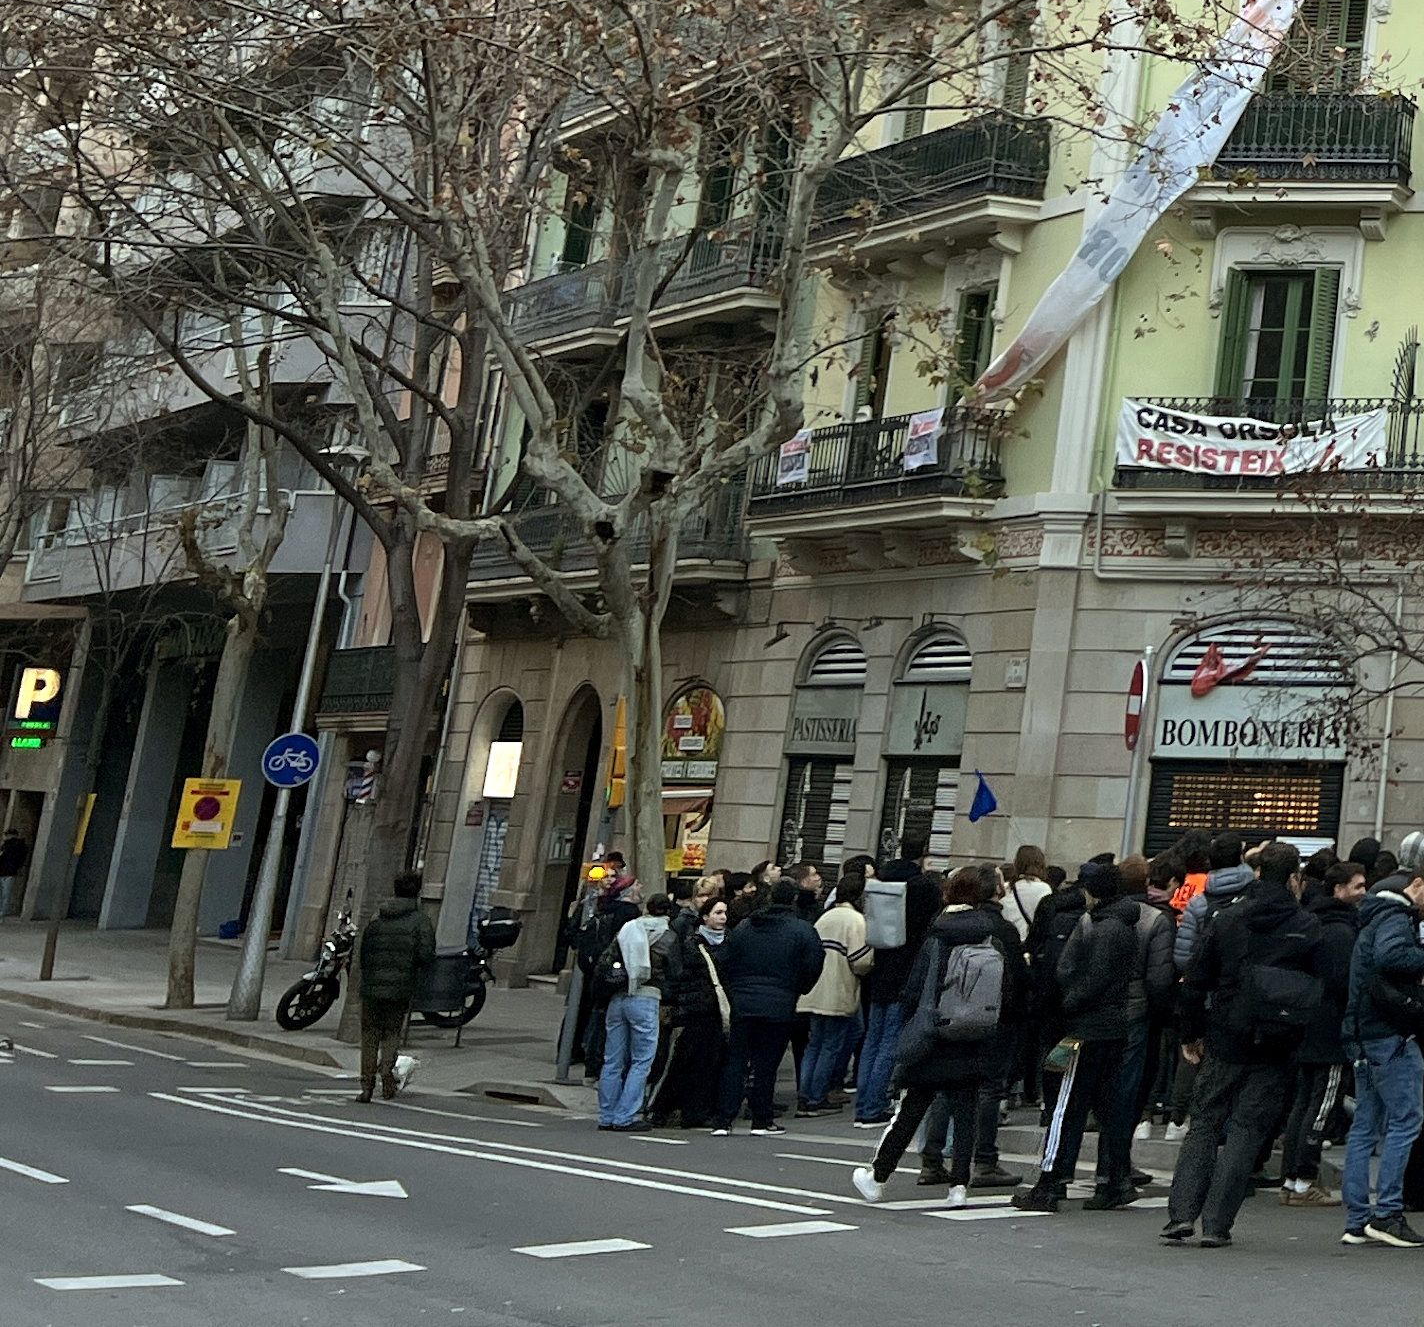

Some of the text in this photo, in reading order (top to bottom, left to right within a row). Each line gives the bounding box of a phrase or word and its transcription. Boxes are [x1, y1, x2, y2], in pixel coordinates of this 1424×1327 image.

[1136, 407, 1336, 441] CASA ORSOLA
[1136, 438, 1287, 474] RESISTEIX
[15, 668, 61, 719] P
[791, 717, 858, 743] PASTISSERIA
[1161, 718, 1343, 748] BOMBONERIA
